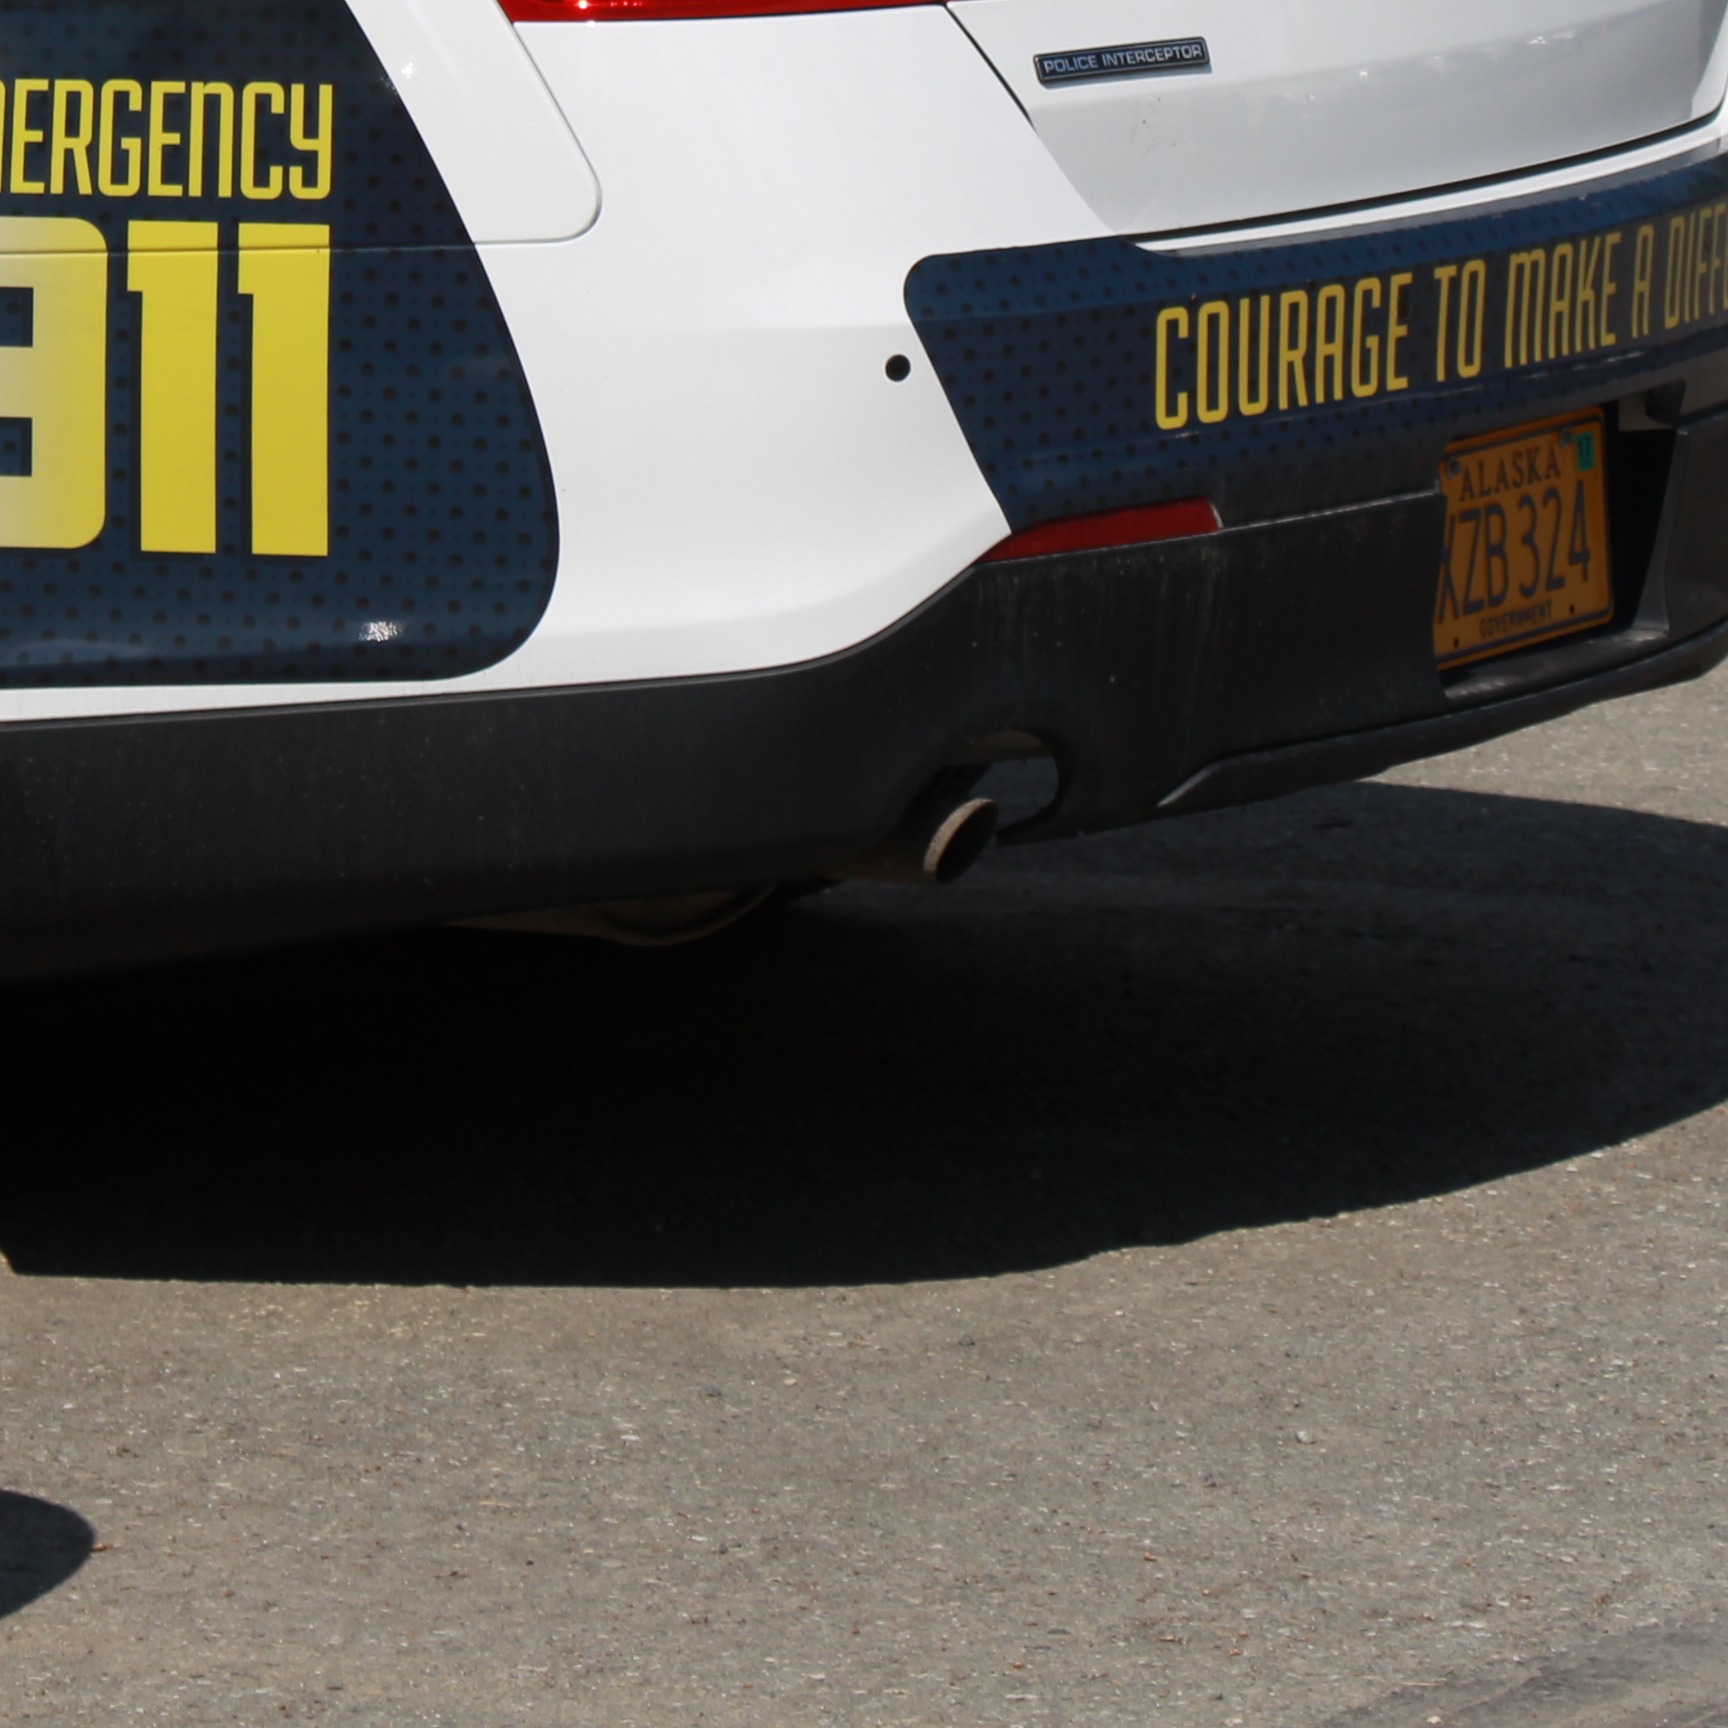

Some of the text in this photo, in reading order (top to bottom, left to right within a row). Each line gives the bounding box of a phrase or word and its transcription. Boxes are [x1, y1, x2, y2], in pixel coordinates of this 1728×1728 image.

[1043, 43, 1203, 74] POLICE INTERCEPTOR
[1155, 272, 1412, 430] COURAGE
[1434, 259, 1487, 382] TO
[1504, 231, 1622, 369] MAKE
[1631, 223, 1655, 338] A
[1459, 442, 1562, 503] ALASKA
[1479, 599, 1553, 639] GOVERNMENT
